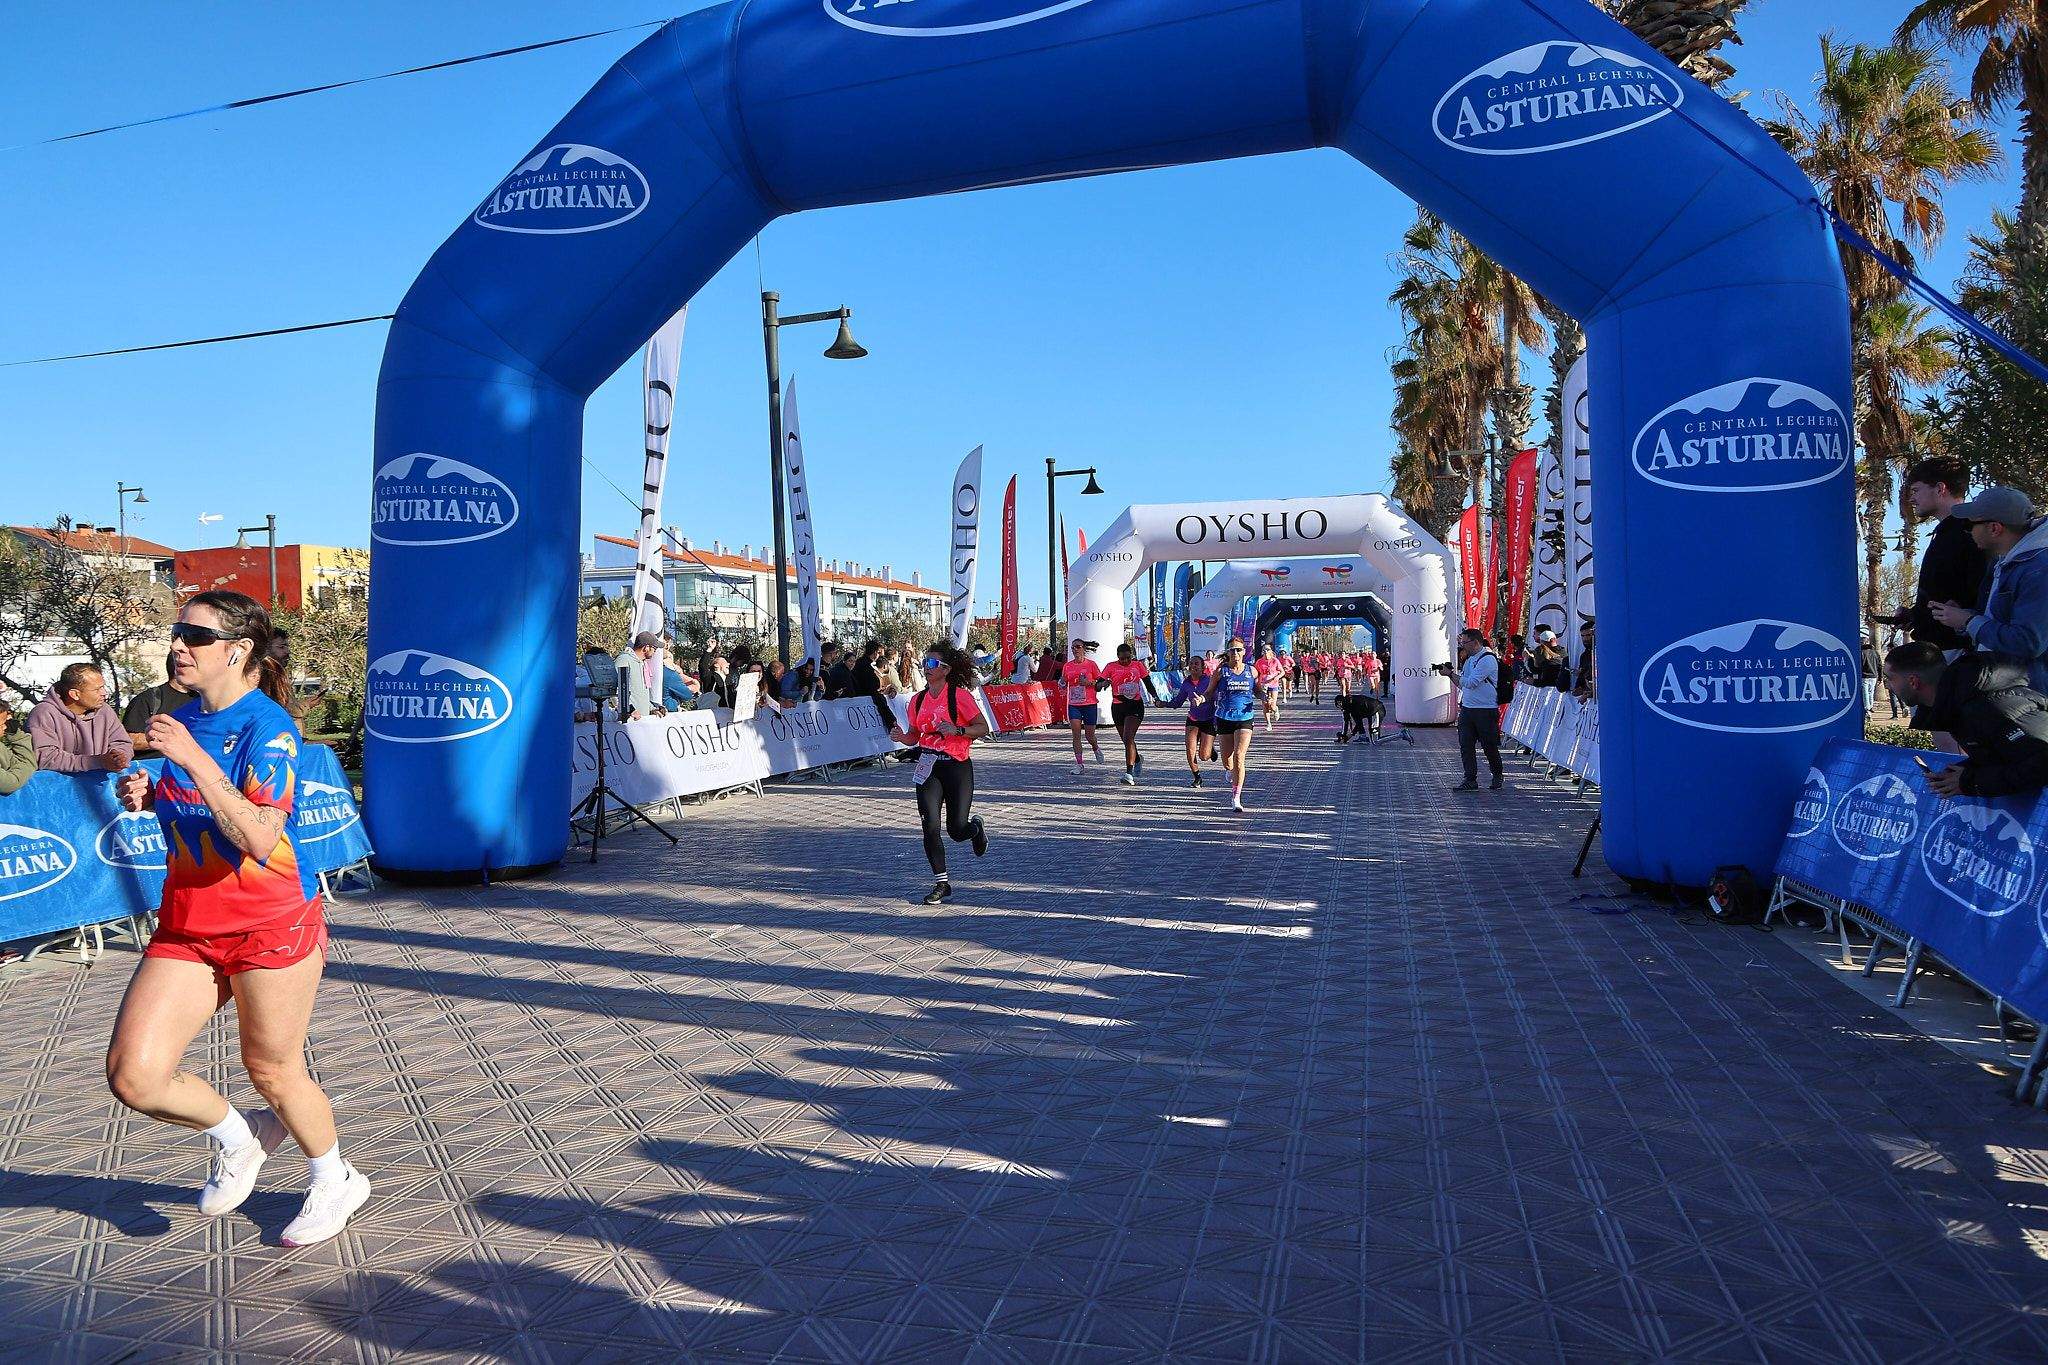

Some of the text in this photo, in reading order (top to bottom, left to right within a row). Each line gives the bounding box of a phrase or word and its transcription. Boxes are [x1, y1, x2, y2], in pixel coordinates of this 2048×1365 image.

[1487, 70, 1654, 98] CENTRAL LECHERA
[1452, 83, 1669, 139] ASTURIANA
[509, 170, 626, 189] CENTRAL LECHERA
[480, 184, 635, 218] ASTURIANA
[1684, 415, 1839, 434] CENTRAL LECHERA
[1648, 428, 1843, 471] ASTURIANA
[381, 485, 498, 497] CENTRAL LECHERA
[1175, 509, 1328, 545] OYSHO
[1373, 538, 1422, 551] OYSHO
[1089, 552, 1133, 563] OYSHO
[1071, 611, 1111, 621] OYSHO
[1291, 603, 1356, 612] VOLVO
[1402, 603, 1447, 615] OYSHO
[1403, 667, 1438, 678] OYSH
[1691, 656, 1846, 670] CENTRAL LECHERA
[374, 681, 491, 693] CENTRAL LECHERA
[1654, 663, 1851, 704] ASTURIANA
[770, 709, 829, 741] OYSHO
[666, 720, 743, 758] OYSHO
